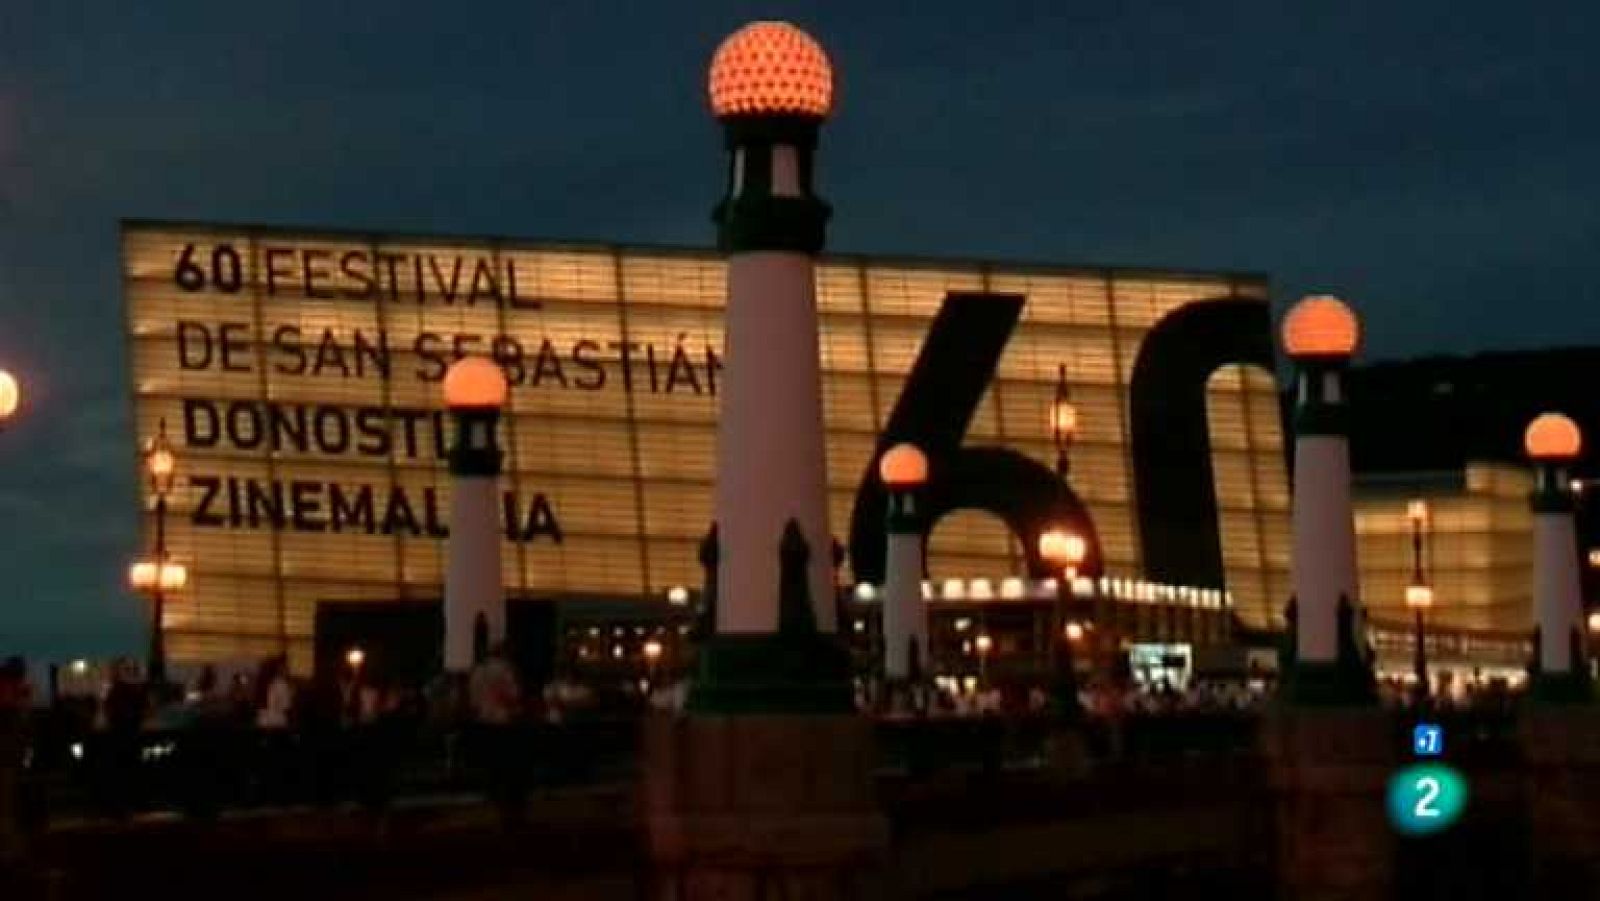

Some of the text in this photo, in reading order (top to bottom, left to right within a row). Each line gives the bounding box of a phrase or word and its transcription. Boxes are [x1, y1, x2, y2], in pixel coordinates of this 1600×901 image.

[175, 243, 541, 309] 60 FESTIVAL
[177, 320, 251, 372] DE
[273, 325, 391, 379] SAN
[183, 398, 500, 460] DONOSTI
[190, 475, 563, 544] ZINEMALIA
